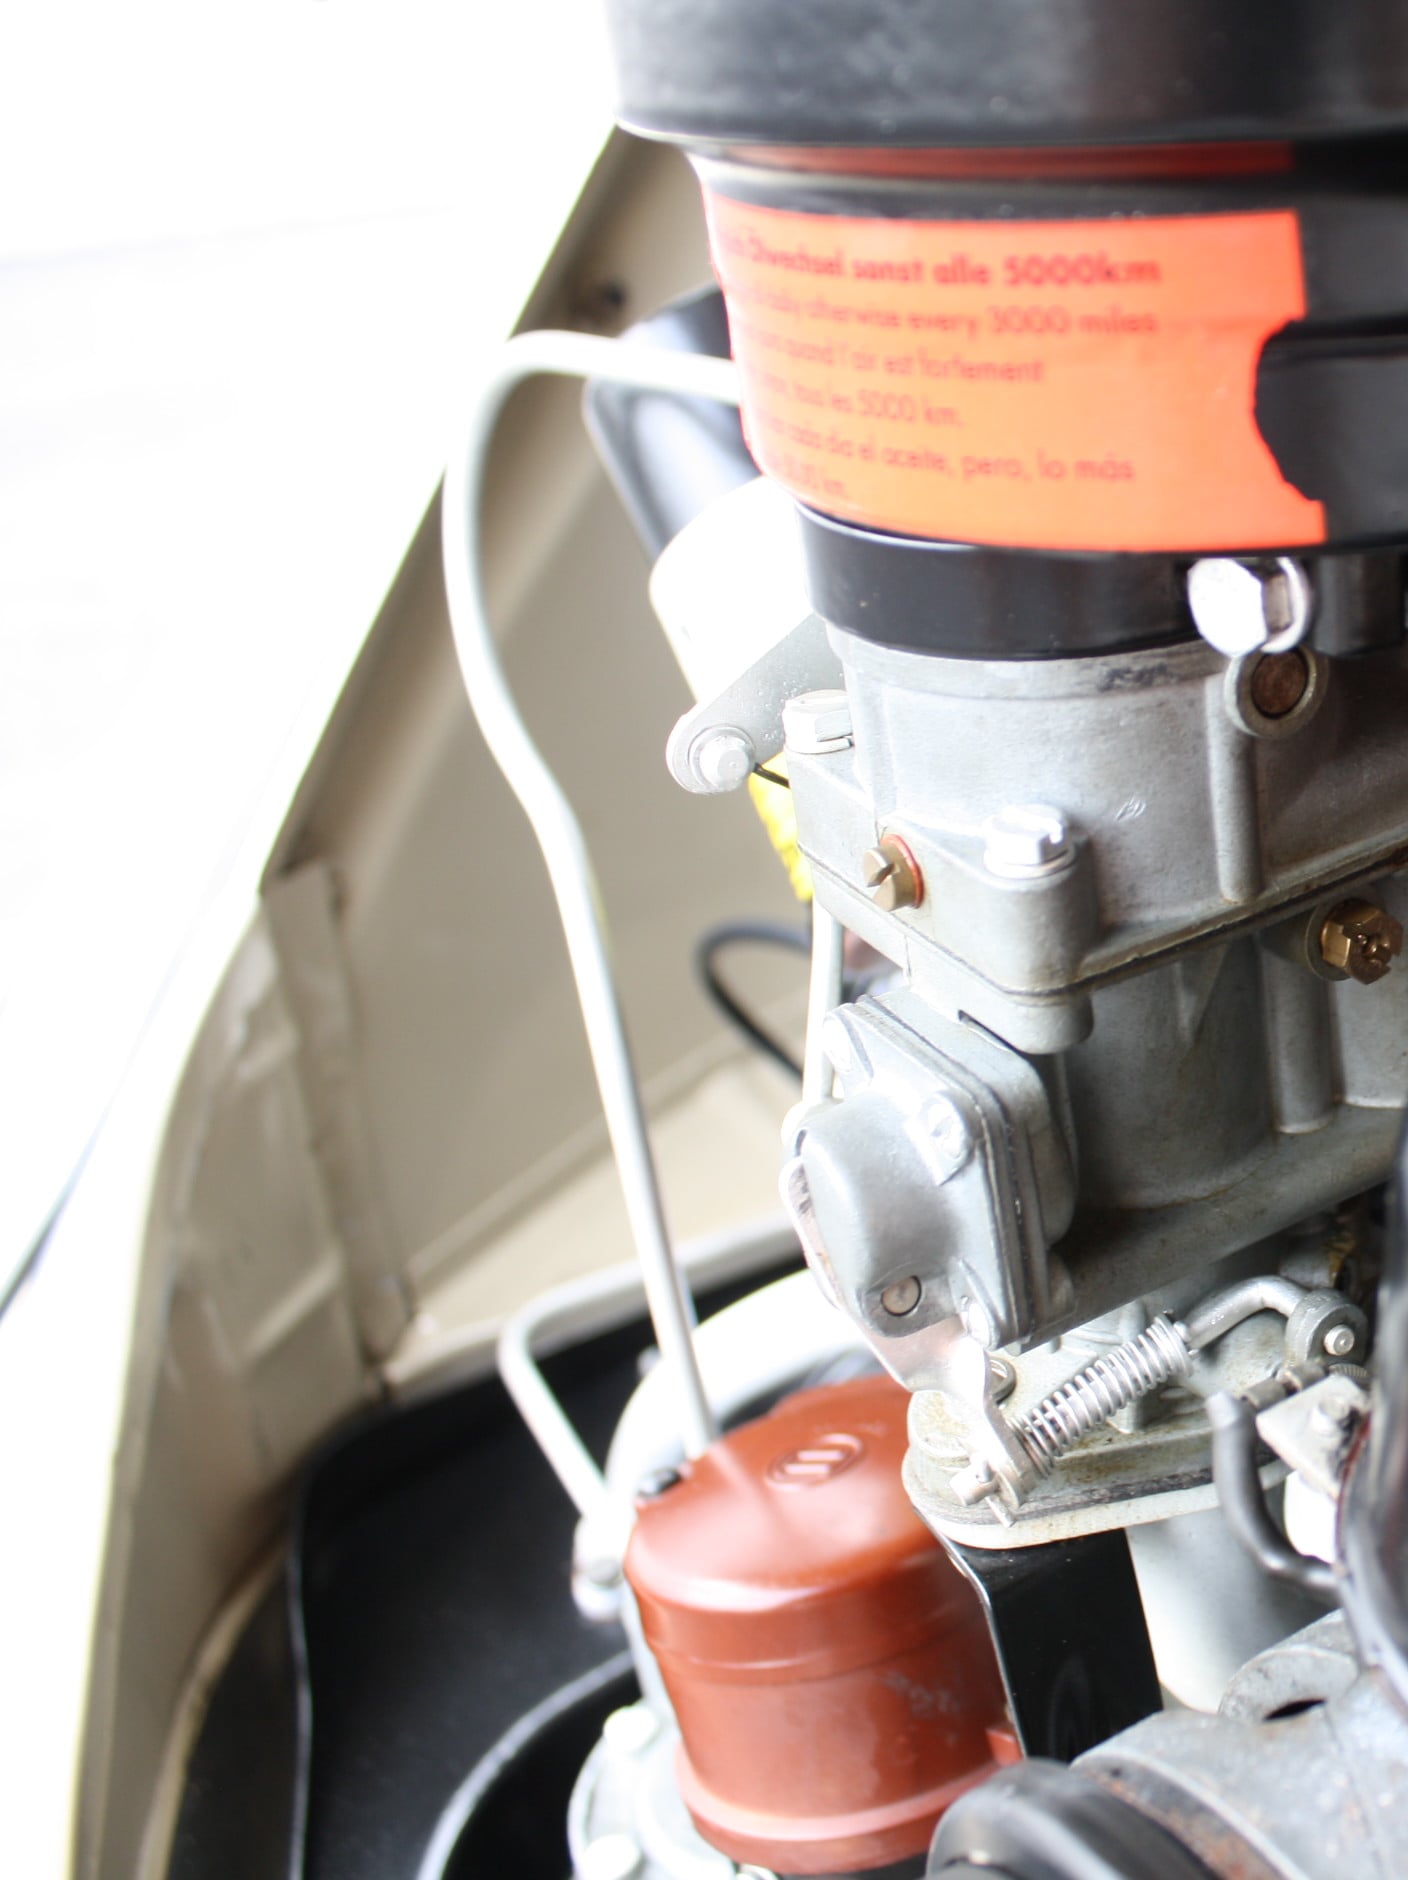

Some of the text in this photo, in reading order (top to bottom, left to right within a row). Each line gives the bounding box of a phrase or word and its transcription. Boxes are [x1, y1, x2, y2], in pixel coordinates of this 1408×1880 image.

[851, 258, 922, 284] sonst
[932, 252, 990, 285] alle
[905, 310, 977, 342] every
[1078, 303, 1159, 336] miles
[918, 346, 1044, 382] fortement
[961, 455, 1033, 487] pero,
[1036, 448, 1067, 480] lo
[1073, 450, 1136, 484] más
